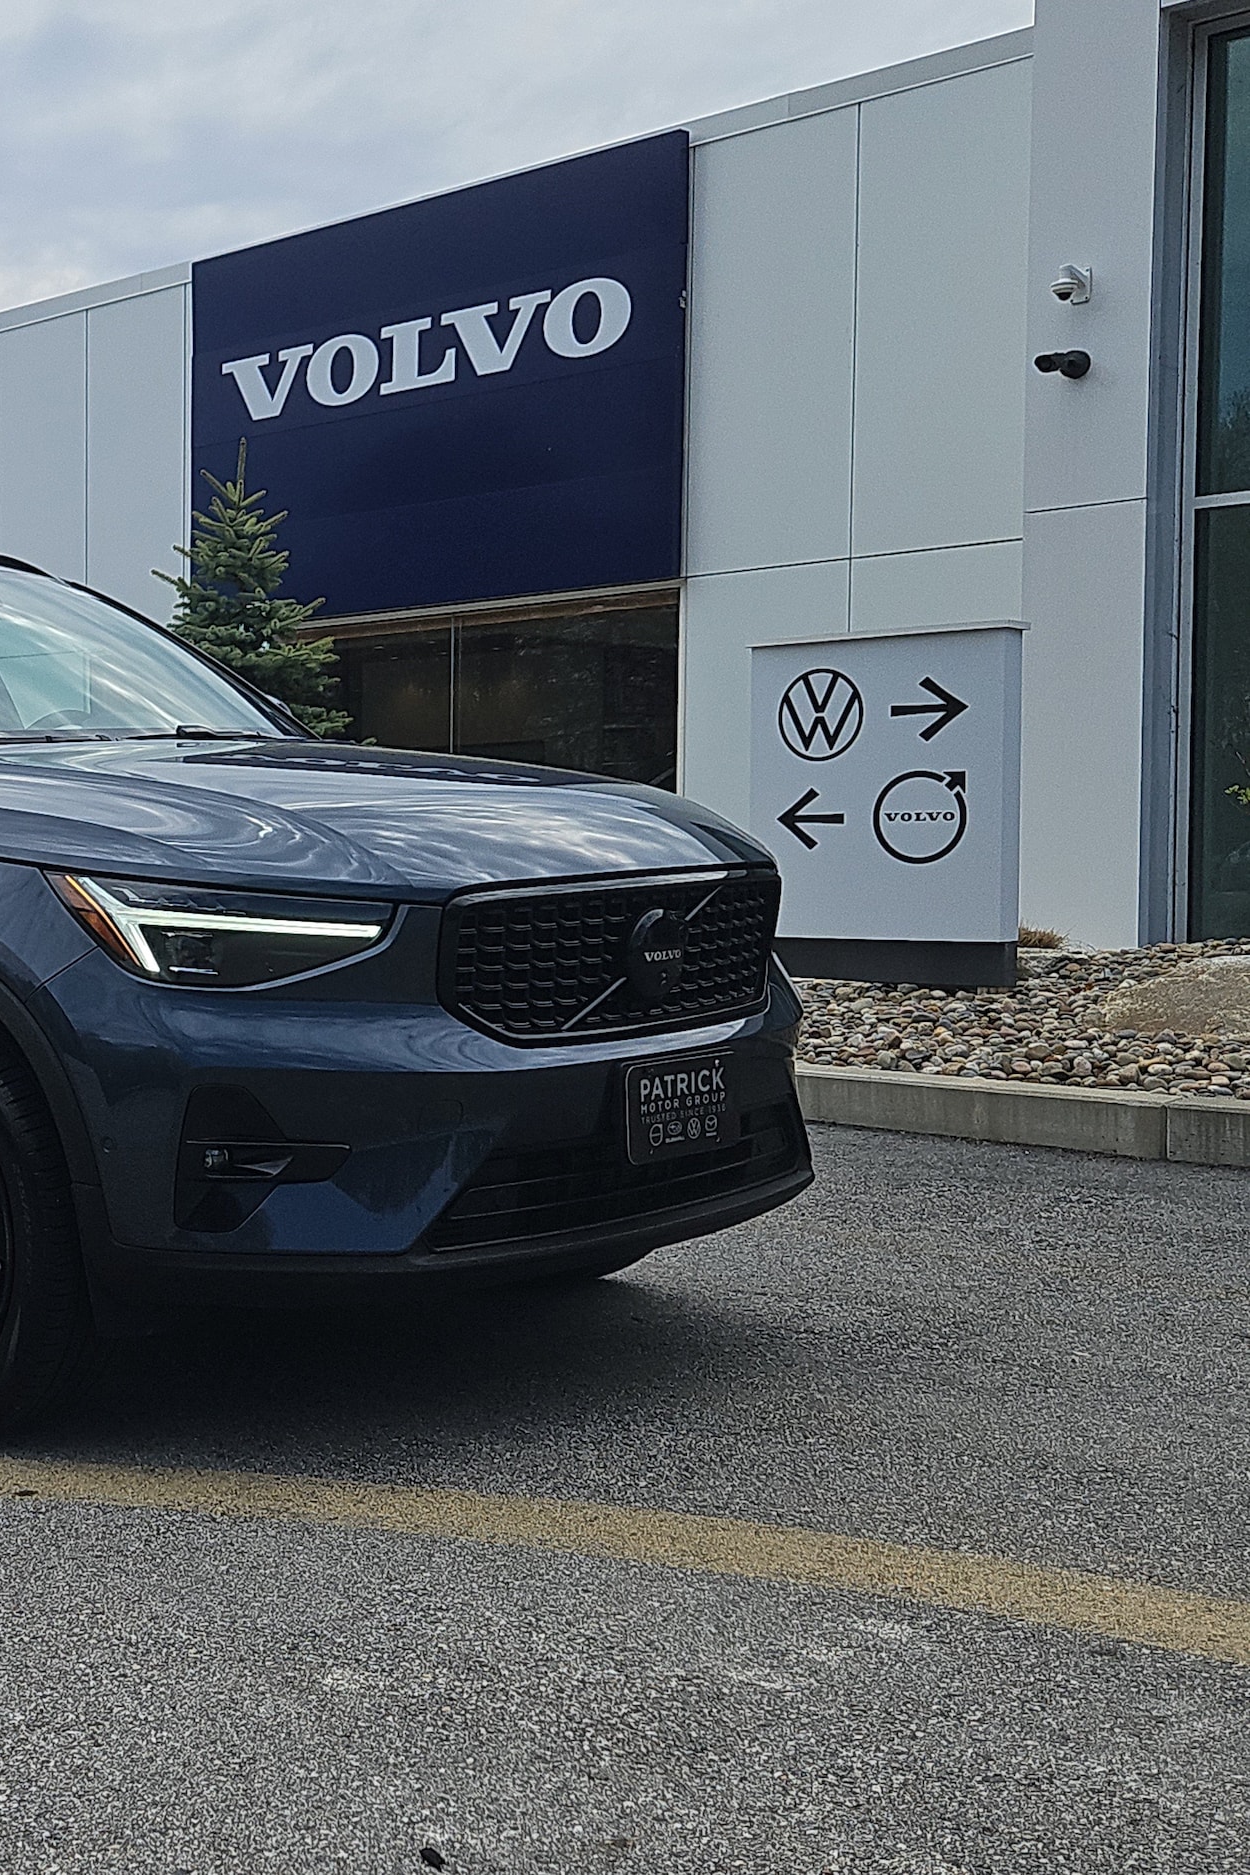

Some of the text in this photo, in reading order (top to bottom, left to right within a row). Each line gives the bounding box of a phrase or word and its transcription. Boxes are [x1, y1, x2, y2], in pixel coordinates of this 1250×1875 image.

[221, 277, 632, 421] VOLVO
[884, 811, 956, 824] VOLVO
[643, 949, 681, 962] VOLVO
[640, 1067, 725, 1102] PATRICK
[641, 1092, 726, 1114] MOTOR GROUP
[641, 1112, 677, 1124] TRUSTED
[680, 1107, 704, 1118] SINCE
